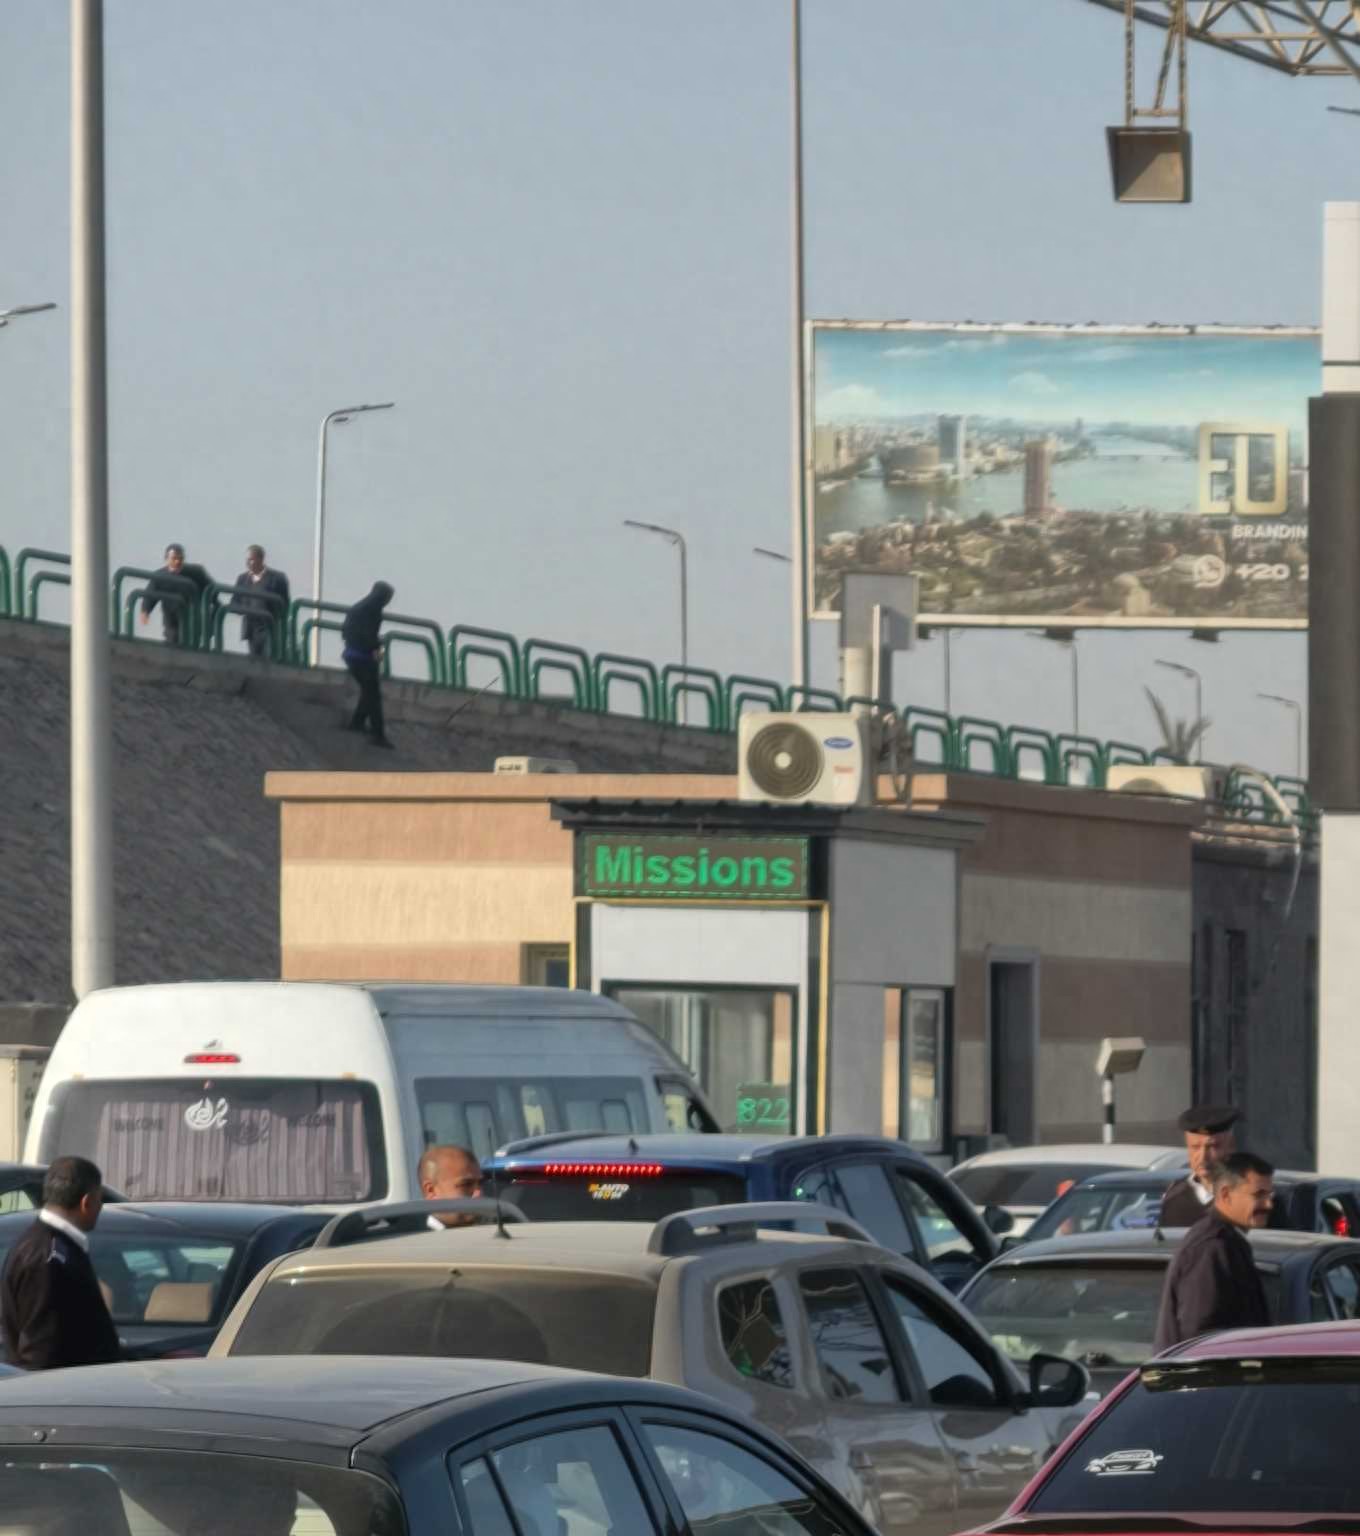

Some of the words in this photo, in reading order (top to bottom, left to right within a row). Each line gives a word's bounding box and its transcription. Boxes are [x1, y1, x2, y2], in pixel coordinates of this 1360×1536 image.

[1232, 524, 1308, 539] BRANDIN
[595, 845, 797, 887] Missions
[738, 1098, 788, 1124] 822
